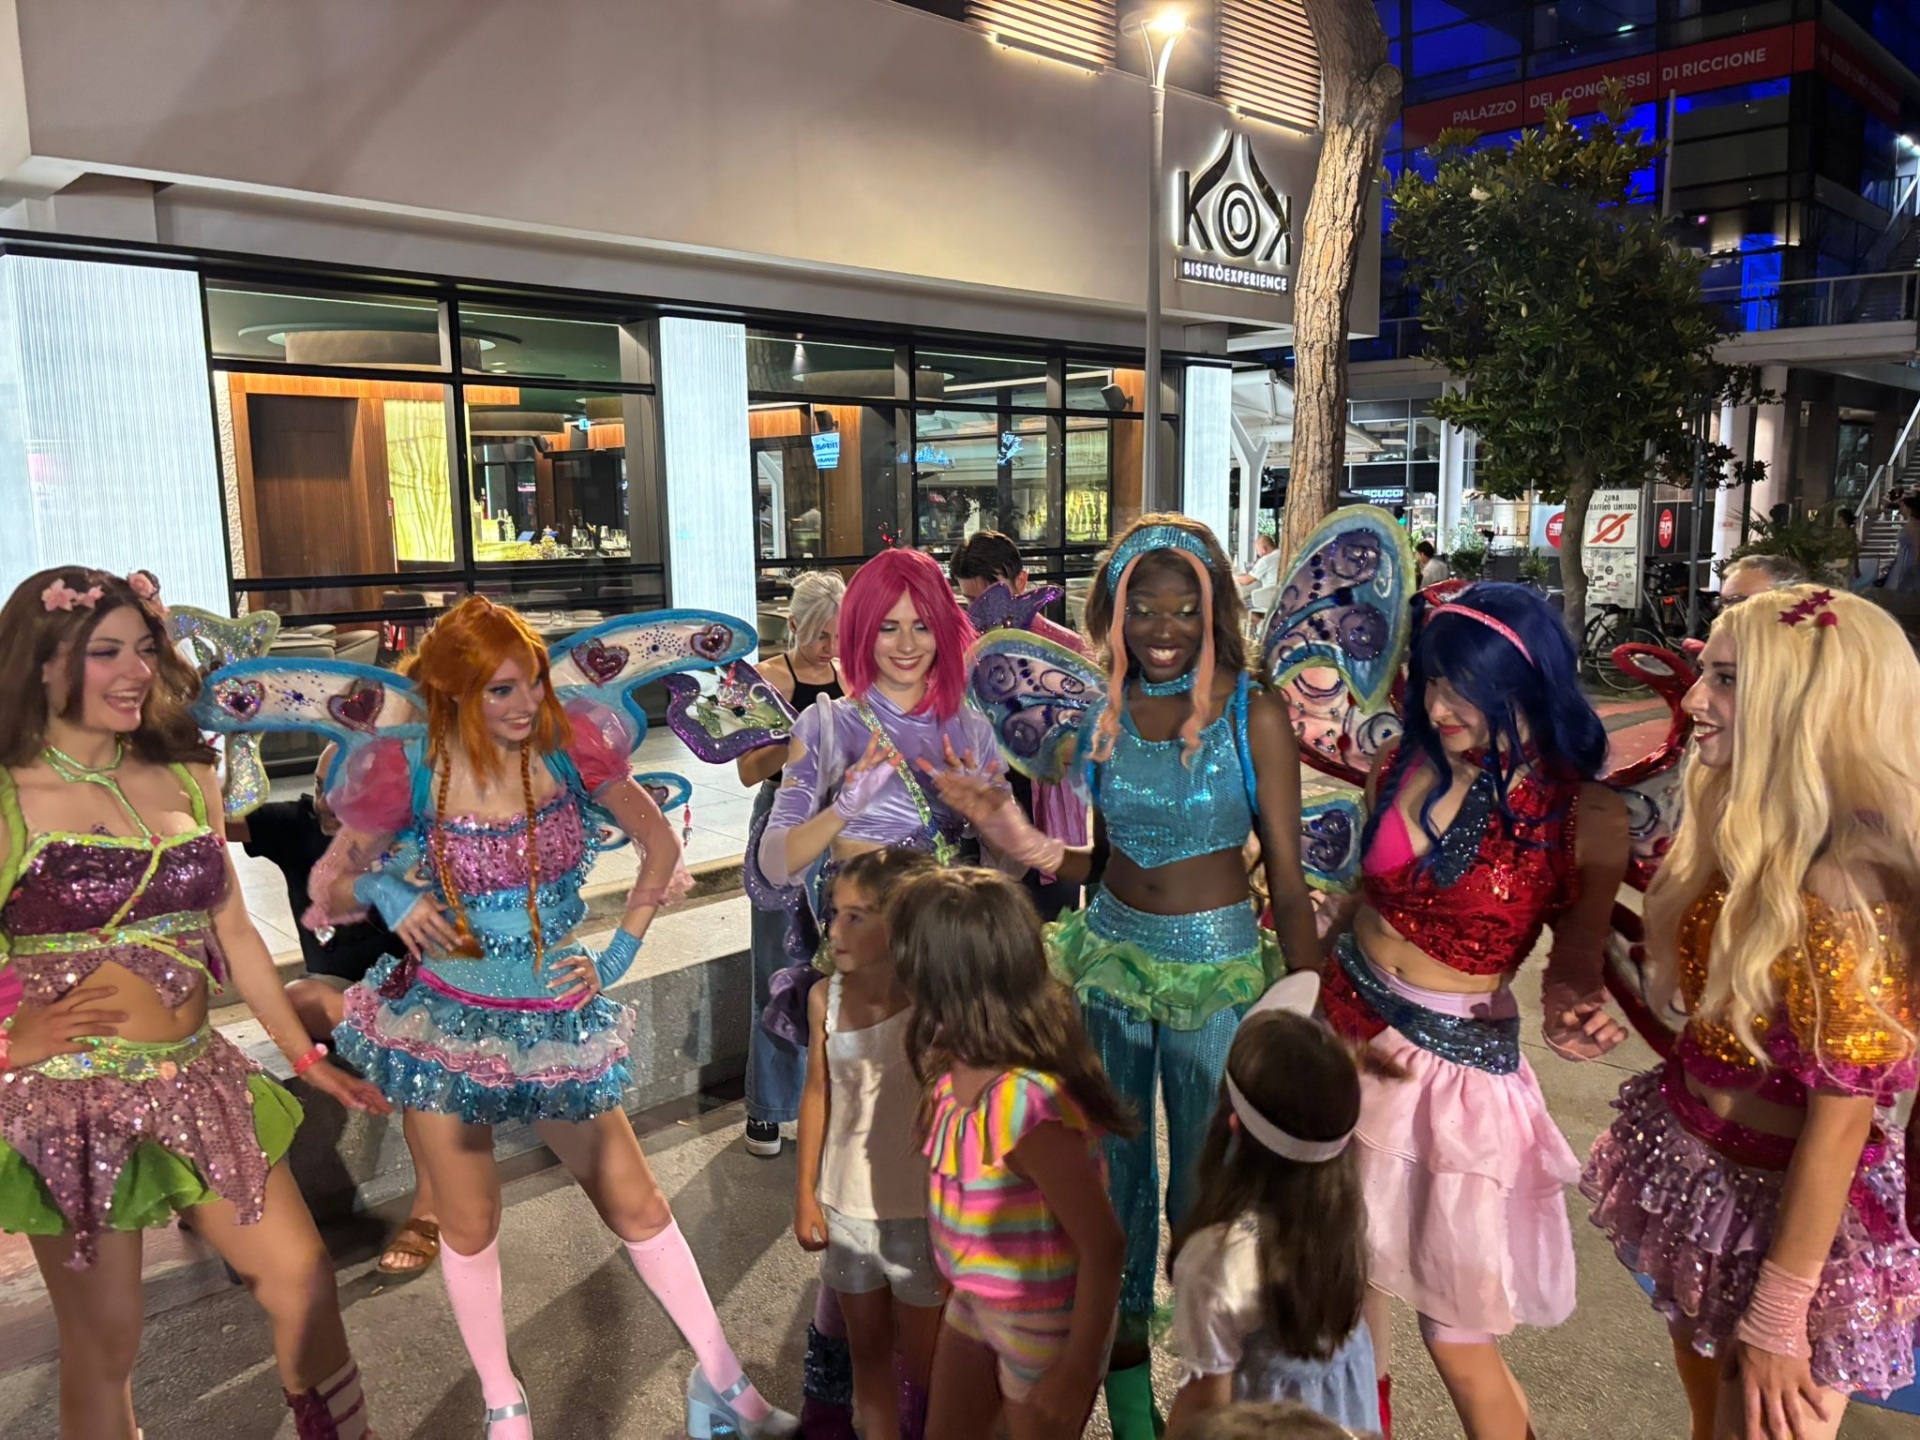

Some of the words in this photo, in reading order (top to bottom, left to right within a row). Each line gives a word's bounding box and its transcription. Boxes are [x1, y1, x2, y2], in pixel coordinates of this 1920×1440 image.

[1453, 99, 1516, 123] PALAZZO
[1561, 72, 1650, 99] CONGESSI
[1662, 65, 1679, 82] DI
[1682, 47, 1767, 77] RICCIONE
[1604, 494, 1620, 502] ZONA
